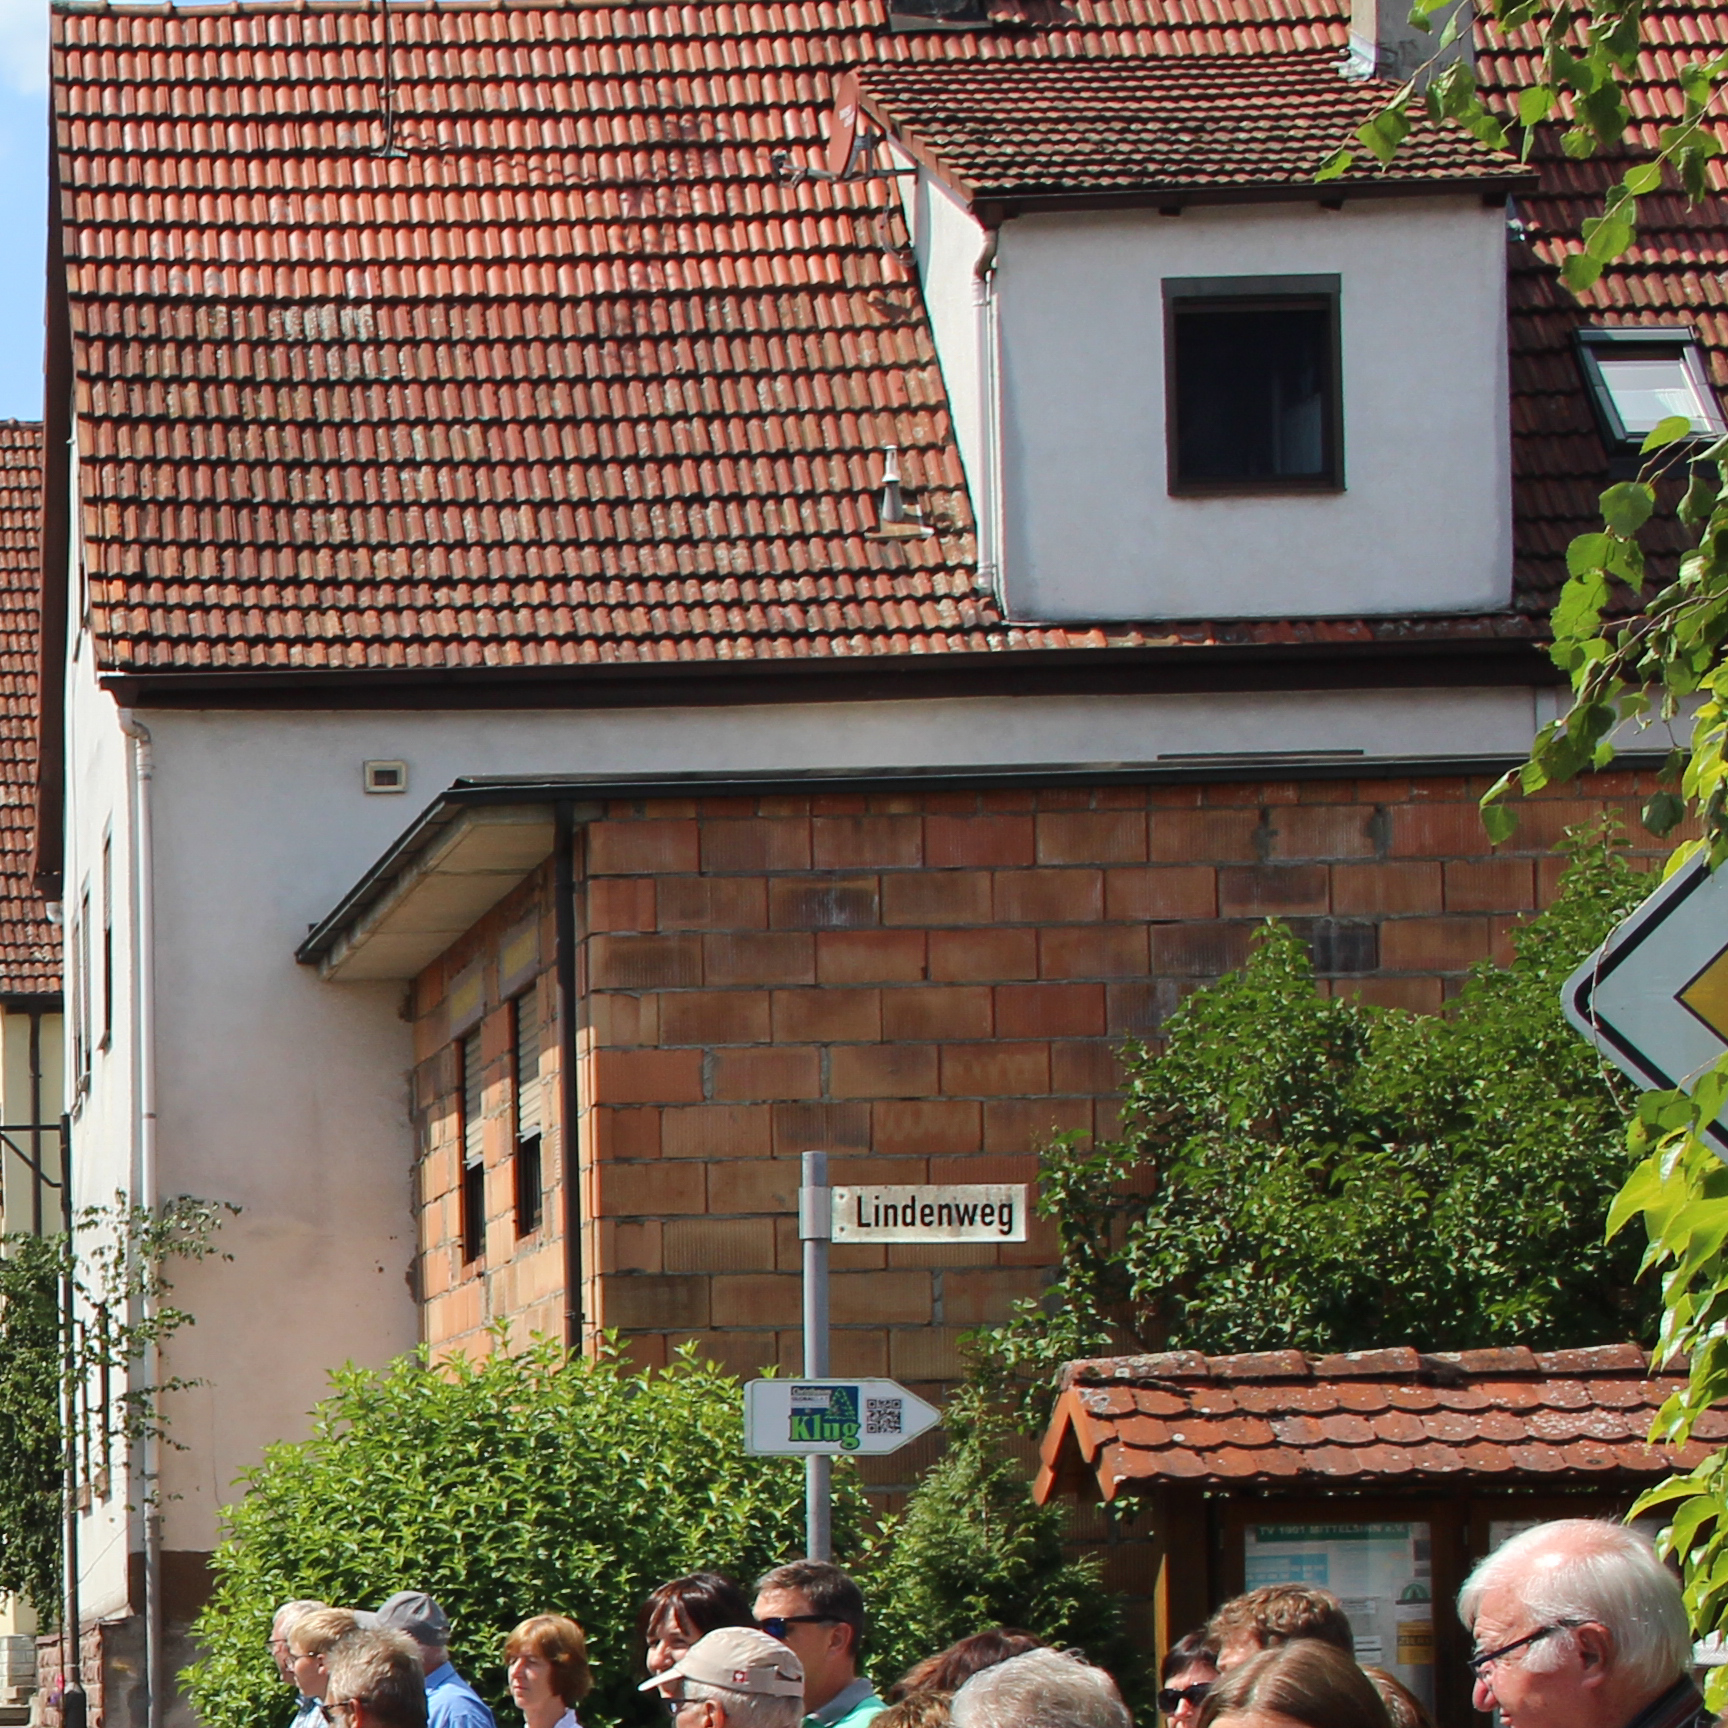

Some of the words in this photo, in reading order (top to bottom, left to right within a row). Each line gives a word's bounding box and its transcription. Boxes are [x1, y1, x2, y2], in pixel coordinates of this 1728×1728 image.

[856, 1195, 1014, 1236] Lindenweg
[788, 1414, 861, 1450] Klug
[1259, 1526, 1275, 1535] TV
